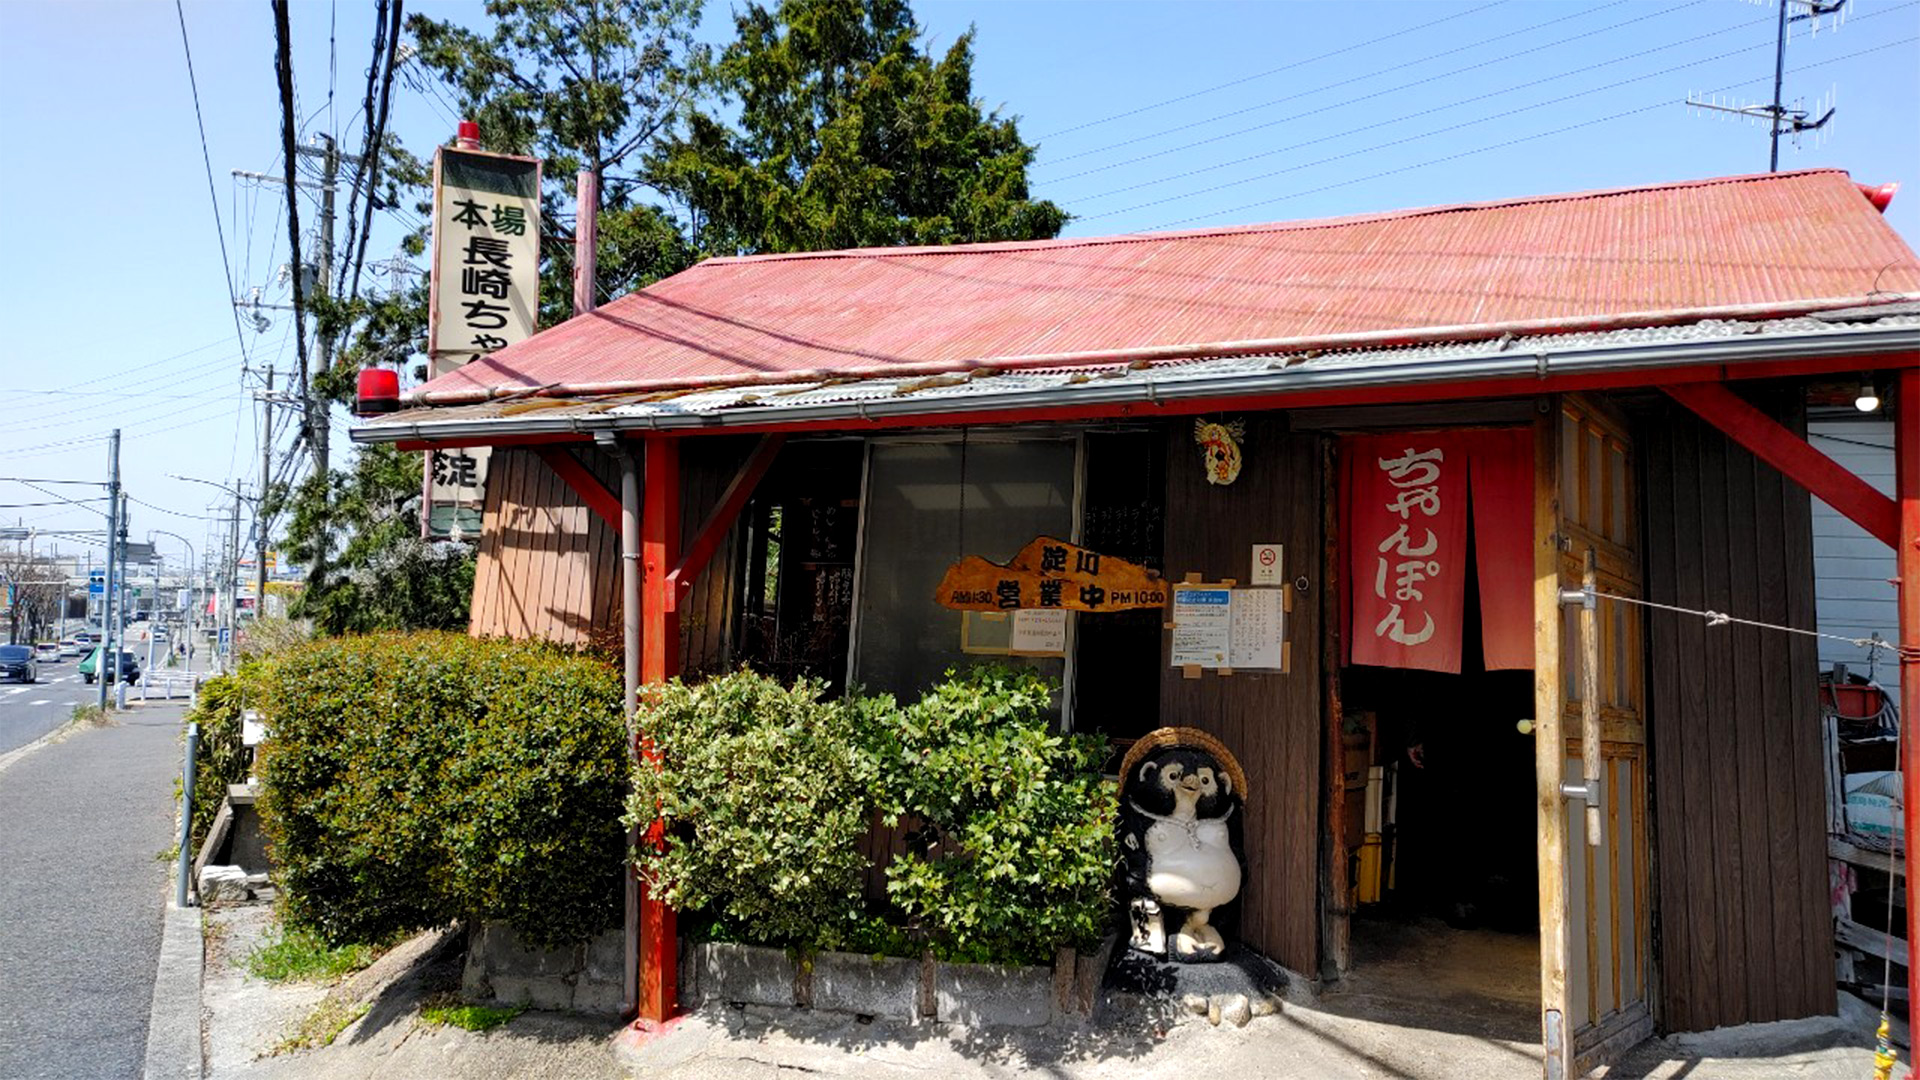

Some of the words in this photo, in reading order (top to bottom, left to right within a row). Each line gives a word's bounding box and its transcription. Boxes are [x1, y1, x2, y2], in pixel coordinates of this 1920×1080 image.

[451, 199, 527, 237] 本場
[460, 235, 514, 365] 長崎ちゃ
[436, 453, 491, 489] 淀
[1041, 545, 1100, 576] 淀川
[1375, 447, 1444, 646] ちゃんぽん
[996, 579, 1105, 609] 営業中
[1111, 592, 1131, 604] PM
[1135, 590, 1165, 604] 10:00
